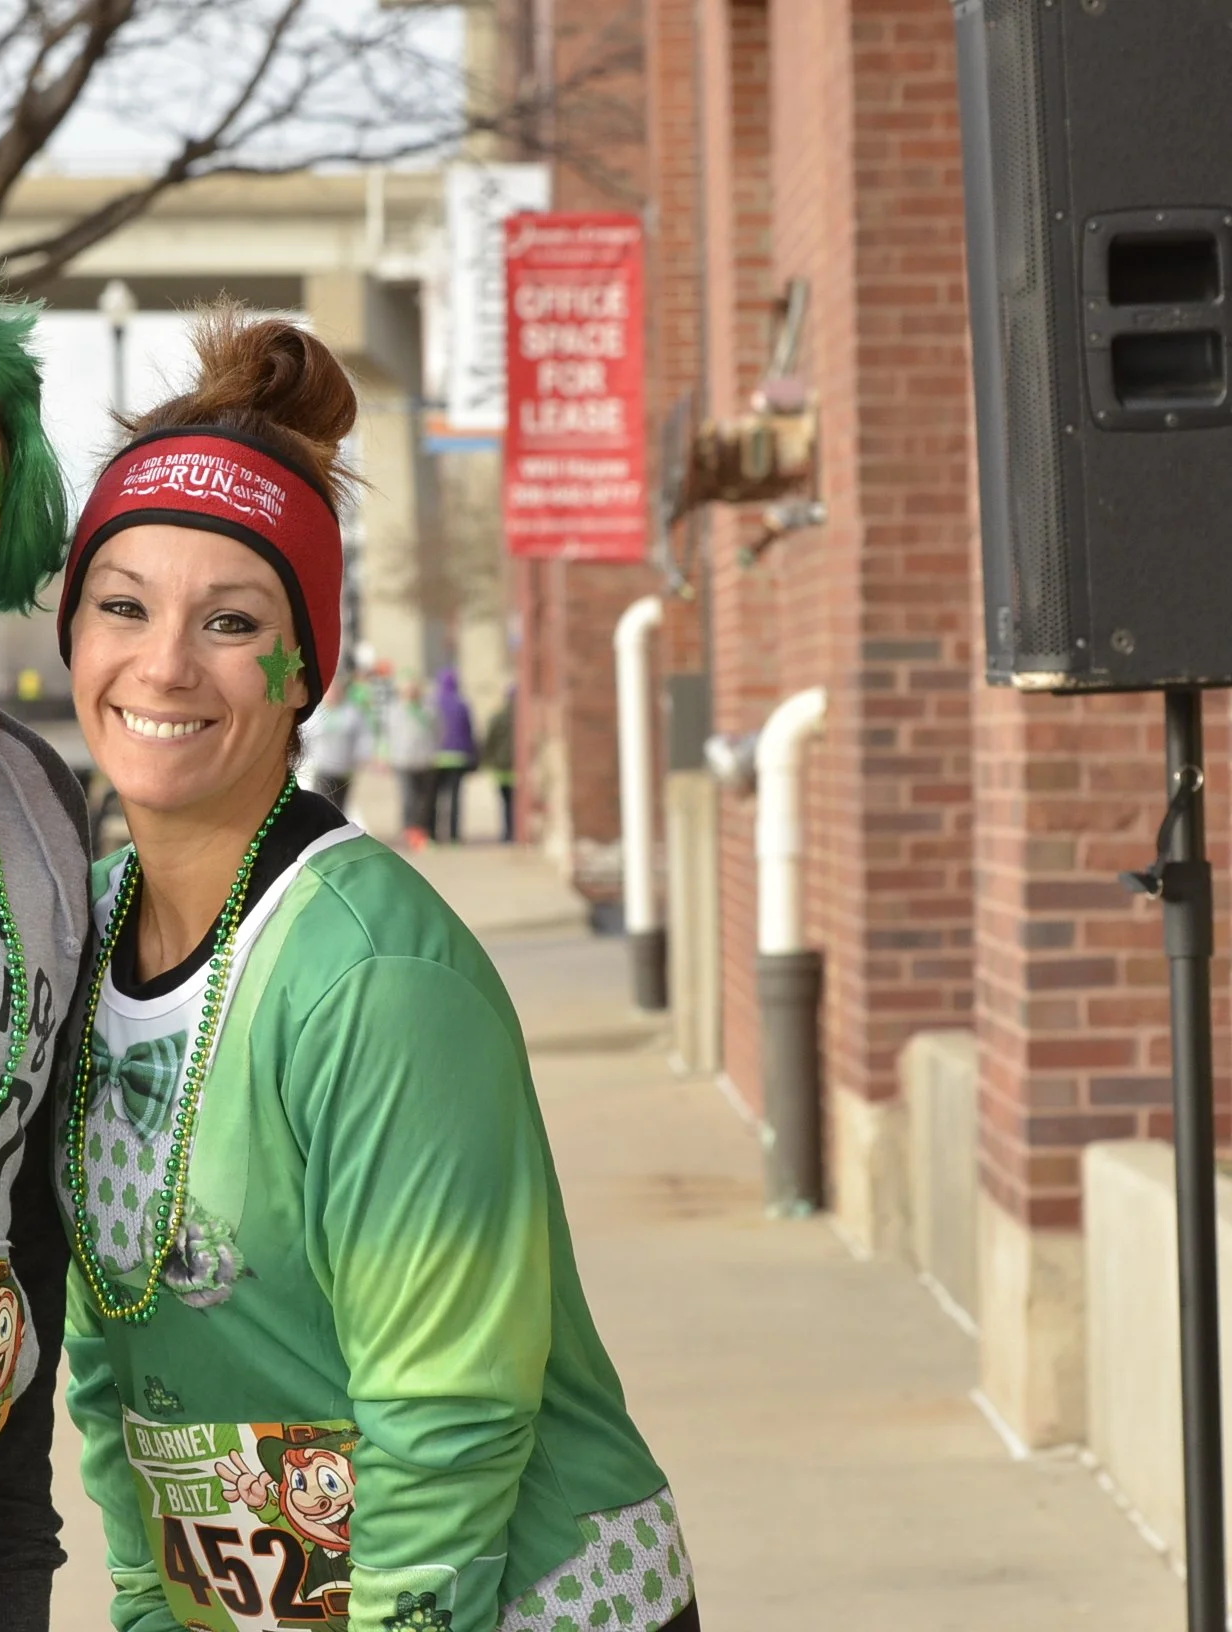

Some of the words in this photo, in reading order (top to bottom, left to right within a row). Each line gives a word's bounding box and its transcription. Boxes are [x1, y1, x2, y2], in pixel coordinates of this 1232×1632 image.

[515, 283, 628, 320] OFFICE
[520, 322, 626, 360] SPACE
[537, 361, 607, 396] FOR
[520, 399, 626, 436] LEASE
[139, 455, 164, 471] JUDE
[165, 453, 237, 474] BARTONVILLE
[239, 467, 252, 482] TO
[254, 475, 287, 502] PEORIA
[169, 465, 236, 493] RUN
[136, 1423, 217, 1459] BLARNEY
[165, 1482, 219, 1513] BLITZ
[161, 1515, 328, 1621] 452
